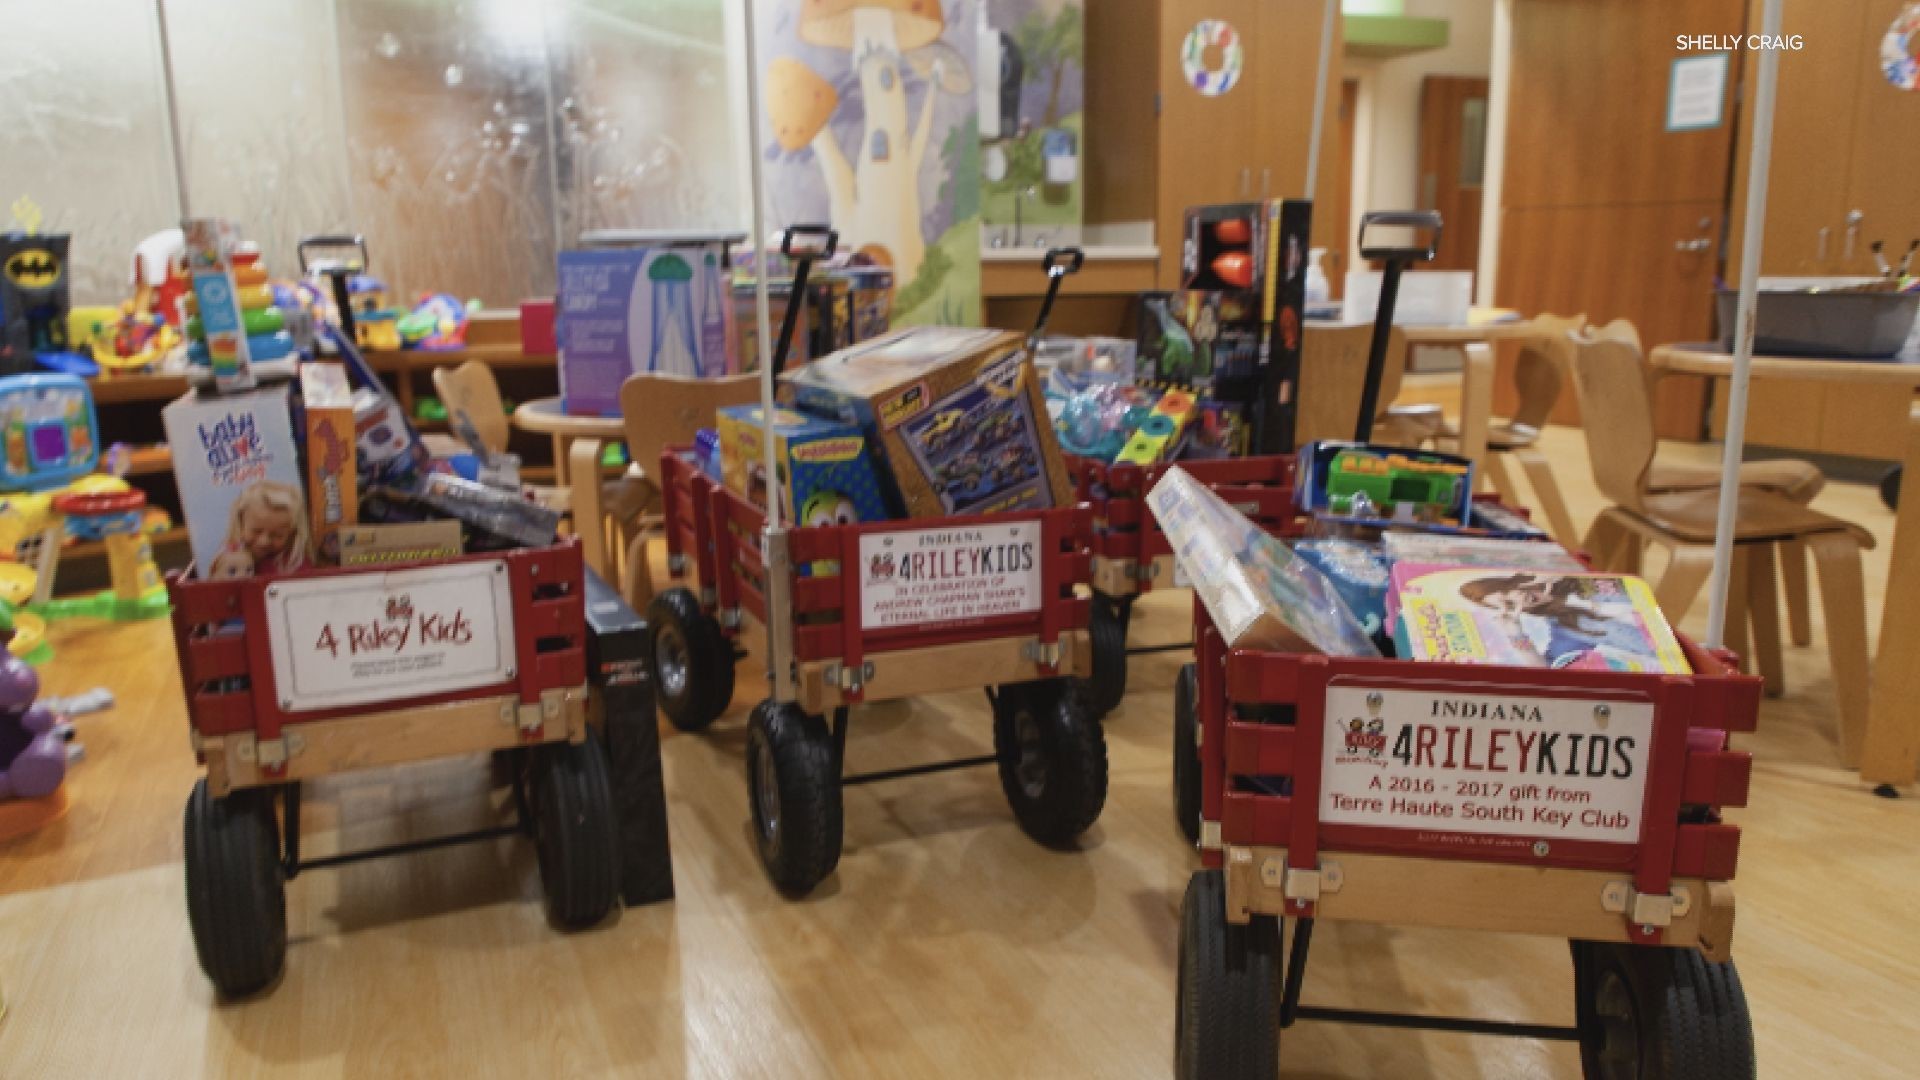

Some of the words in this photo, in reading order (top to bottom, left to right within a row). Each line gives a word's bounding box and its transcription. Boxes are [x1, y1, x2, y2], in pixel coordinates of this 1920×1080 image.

[918, 531, 983, 546] INDIANA
[899, 541, 1033, 581] 4RILEYKIDS
[315, 621, 340, 660] 4
[348, 618, 411, 656] Riley
[419, 606, 473, 646] Kids
[1430, 699, 1544, 723] INDIANA
[1392, 723, 1636, 779] 4RILEYKIDS
[1369, 775, 1382, 791] A
[1388, 777, 1435, 794] 2016
[1456, 780, 1504, 797] 2017
[1509, 783, 1541, 803] gift
[1546, 785, 1591, 804] from
[1330, 792, 1383, 813] Terre
[1390, 794, 1454, 819] Haute
[1461, 801, 1523, 823] South
[1533, 806, 1573, 829] Key
[1581, 808, 1630, 829] Club
